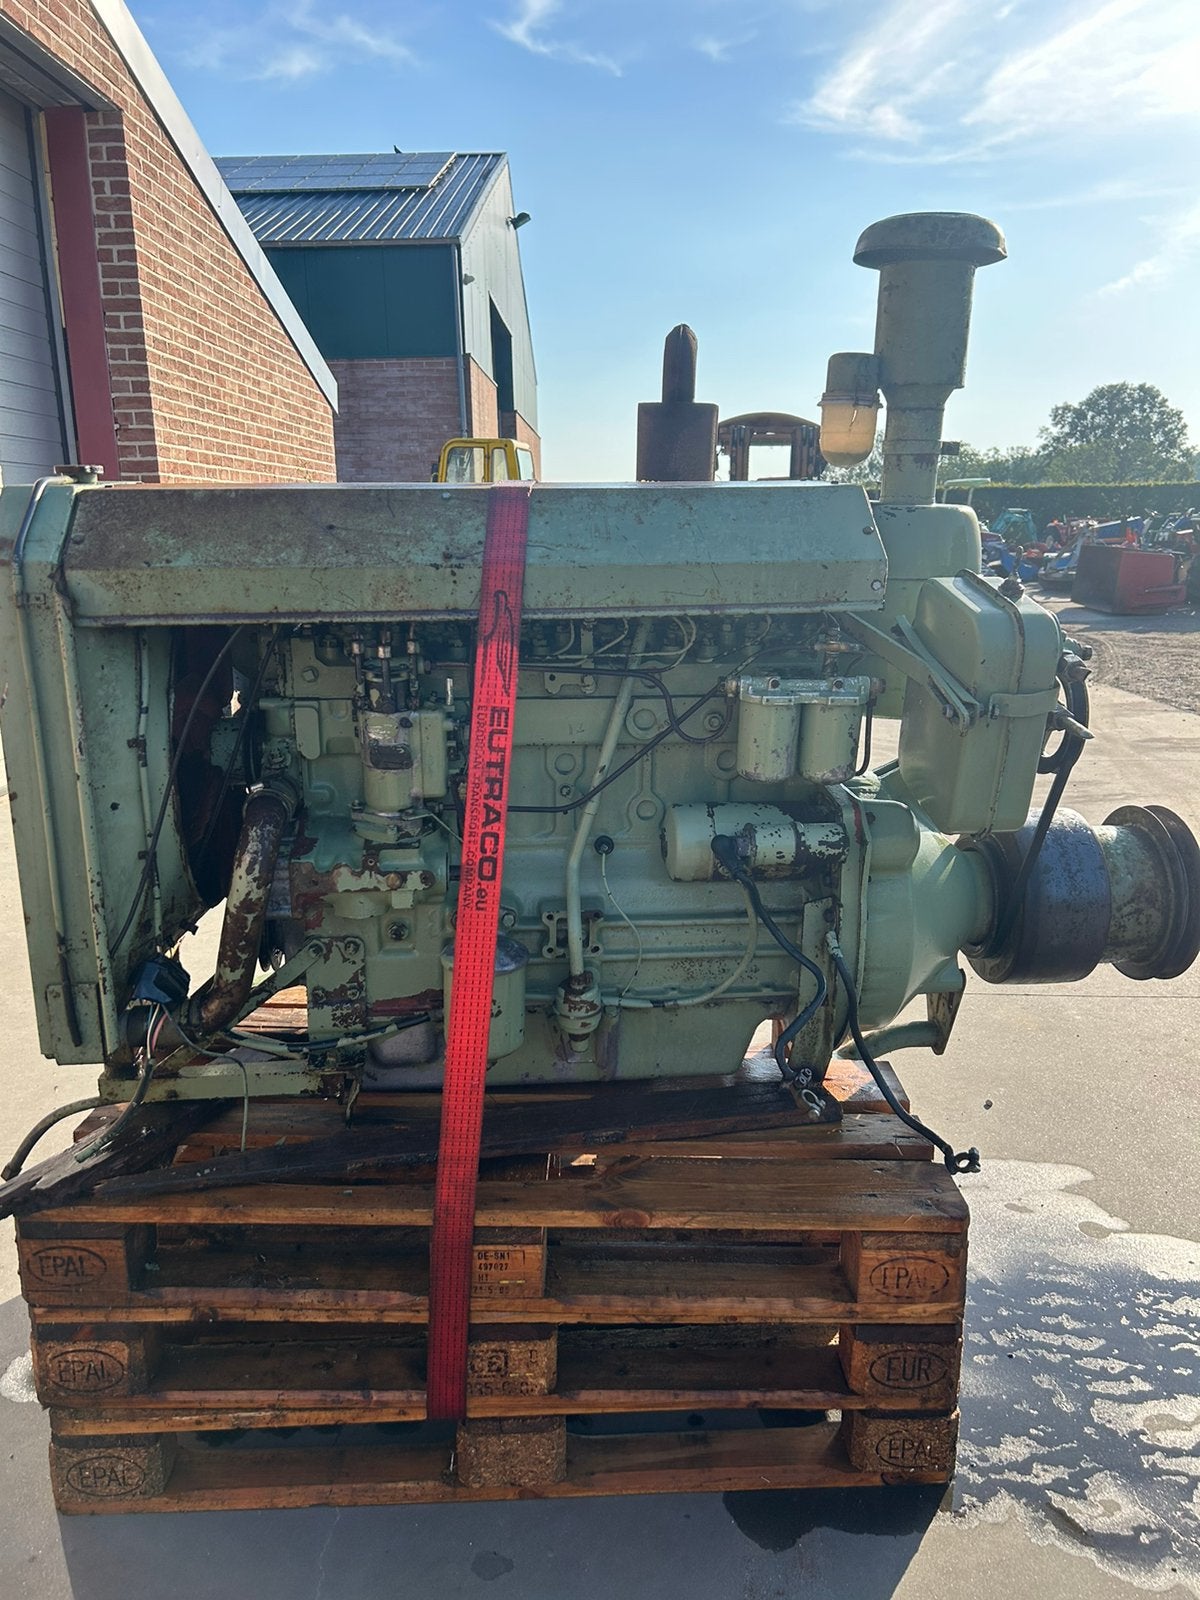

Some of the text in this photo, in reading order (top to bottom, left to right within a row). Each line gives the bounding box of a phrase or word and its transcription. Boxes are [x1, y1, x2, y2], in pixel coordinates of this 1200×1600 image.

[467, 774, 481, 845] TRANSPORT
[475, 706, 510, 911] EUTRACO.eu
[462, 850, 475, 909] COMPANY
[39, 1255, 94, 1277] EPAL
[886, 1357, 931, 1381] EUR
[79, 1466, 131, 1487] EPAL
